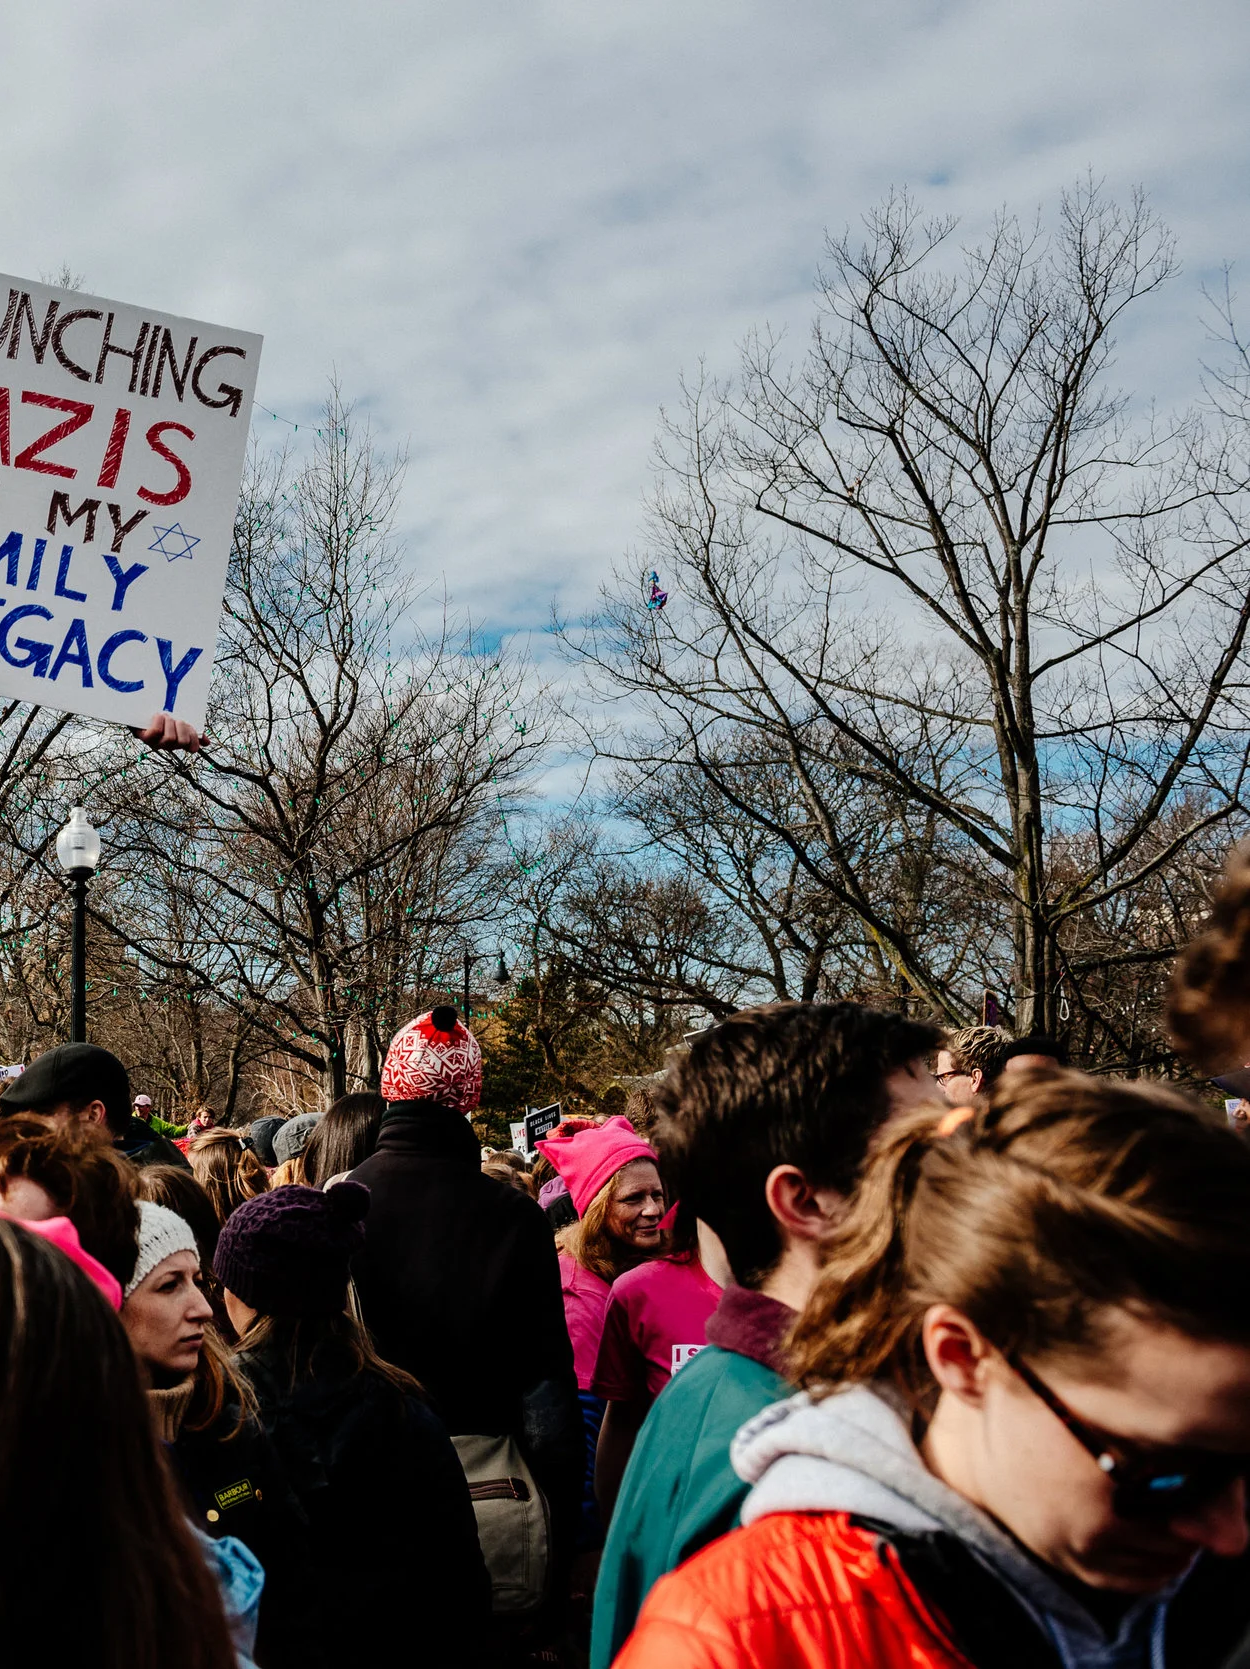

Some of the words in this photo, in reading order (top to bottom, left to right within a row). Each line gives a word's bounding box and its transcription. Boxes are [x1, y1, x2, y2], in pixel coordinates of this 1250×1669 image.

[44, 489, 150, 553] MY
[675, 1348, 681, 1363] I
[218, 1482, 249, 1502] BARBOUR
